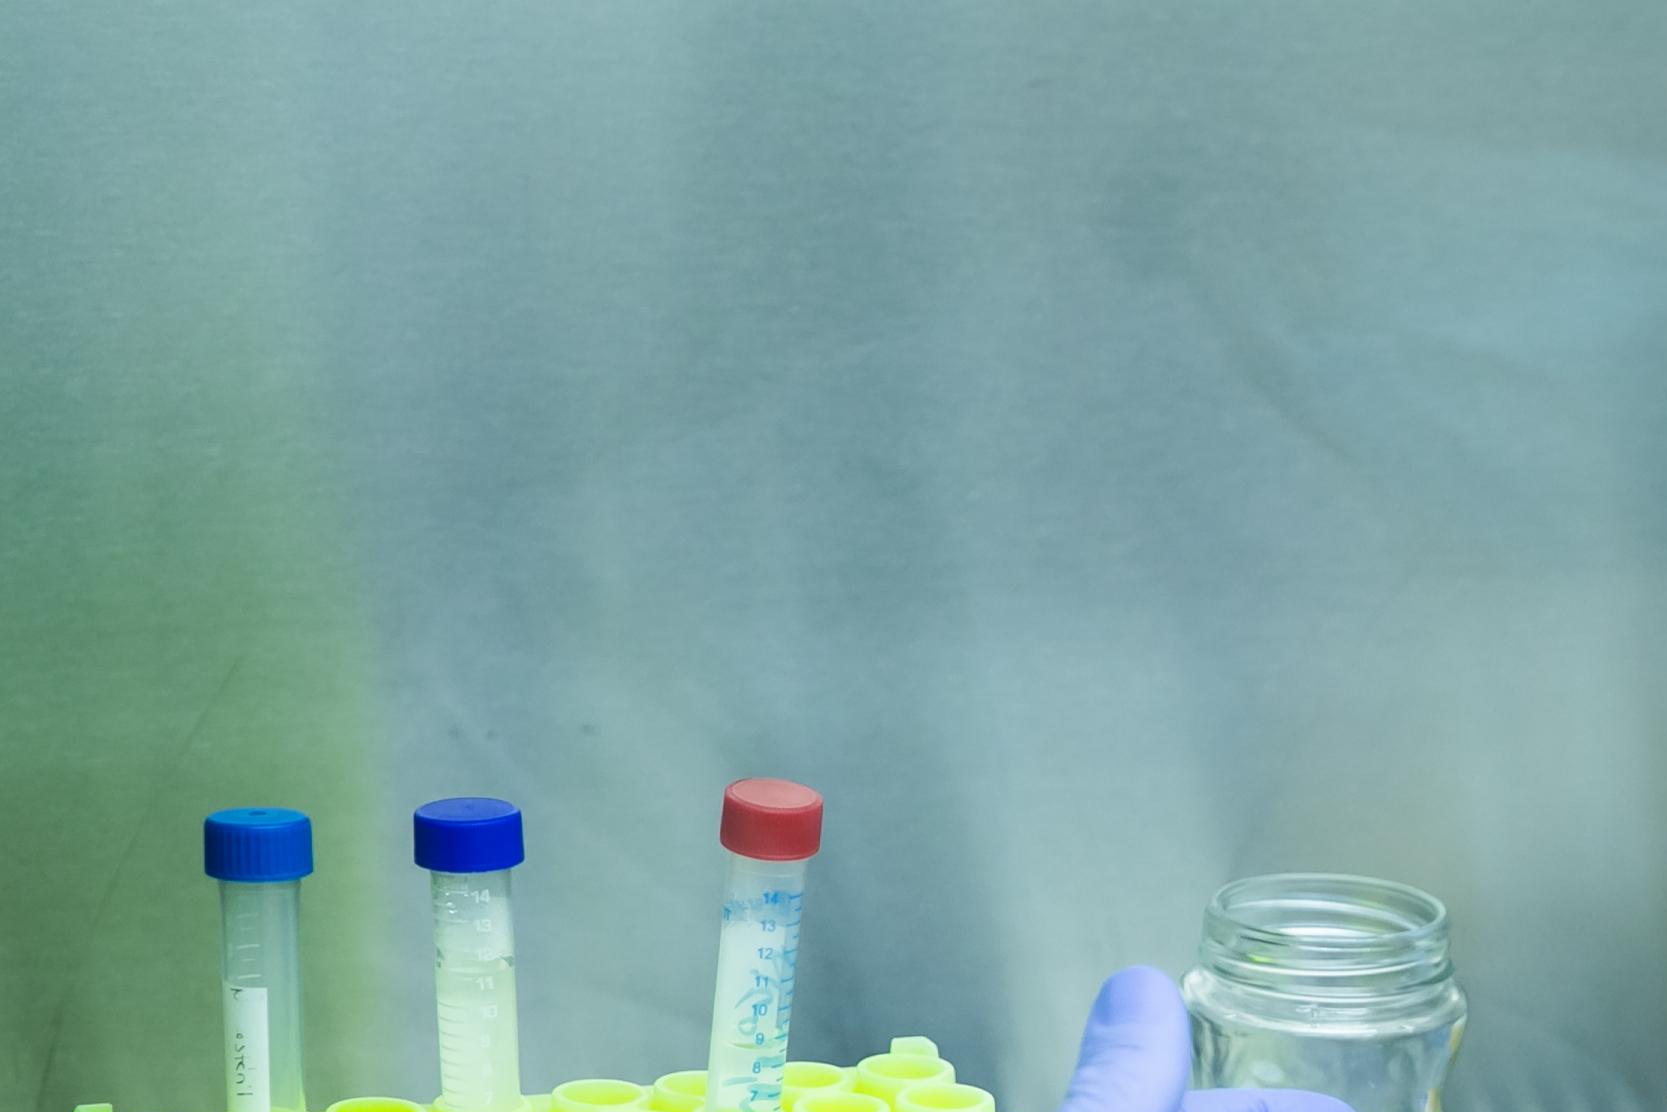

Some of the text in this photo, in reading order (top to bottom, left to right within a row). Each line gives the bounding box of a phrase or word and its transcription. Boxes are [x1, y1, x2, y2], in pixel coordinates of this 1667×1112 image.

[470, 889, 490, 903] 14
[762, 891, 780, 904] 14
[760, 919, 776, 932] 13
[757, 947, 773, 960] 12
[475, 976, 495, 990] 11
[755, 975, 769, 989] 11
[752, 1003, 768, 1016] 10
[755, 1033, 765, 1046] 9
[752, 1061, 762, 1074] 8
[750, 1089, 759, 1102] 7
